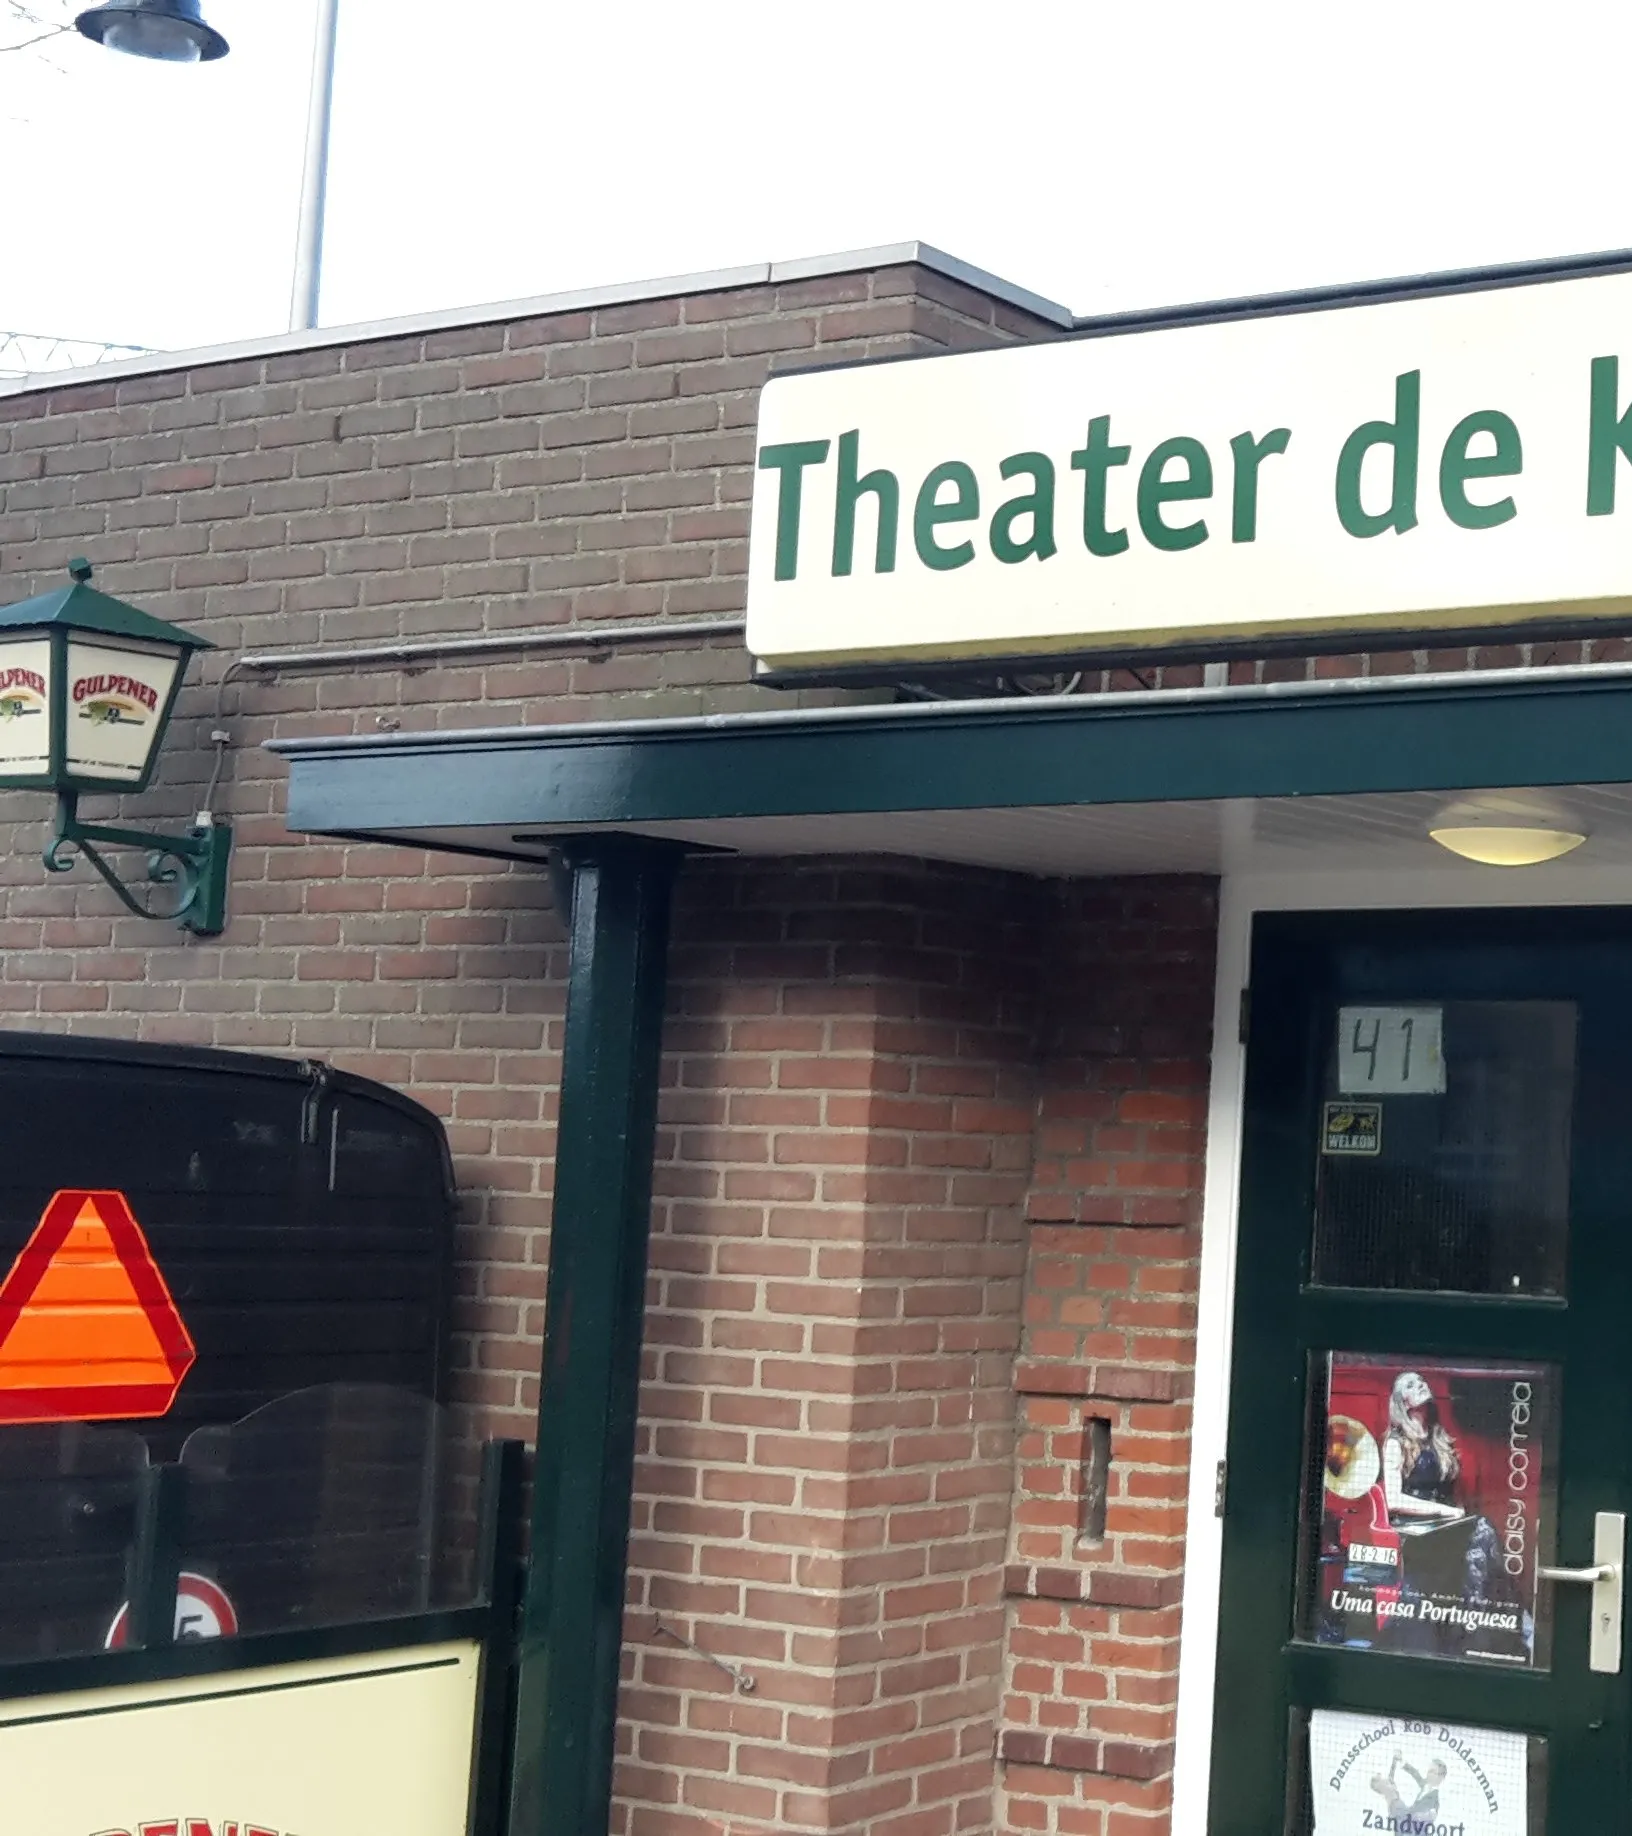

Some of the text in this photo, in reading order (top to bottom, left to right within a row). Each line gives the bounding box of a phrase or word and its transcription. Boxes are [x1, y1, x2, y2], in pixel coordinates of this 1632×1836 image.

[758, 413, 1292, 582] Theater
[1335, 369, 1523, 540] de
[72, 674, 158, 712] GULPENER
[1353, 1018, 1414, 1081] 41
[1328, 1134, 1376, 1149] WELKOM
[1504, 1381, 1532, 1575] daisy correia
[1331, 1588, 1517, 1631] Uma casa Portuguesa
[1329, 1719, 1499, 1815] Dansschool Rob Dolderman
[1362, 1807, 1465, 1836] Zandvoort
